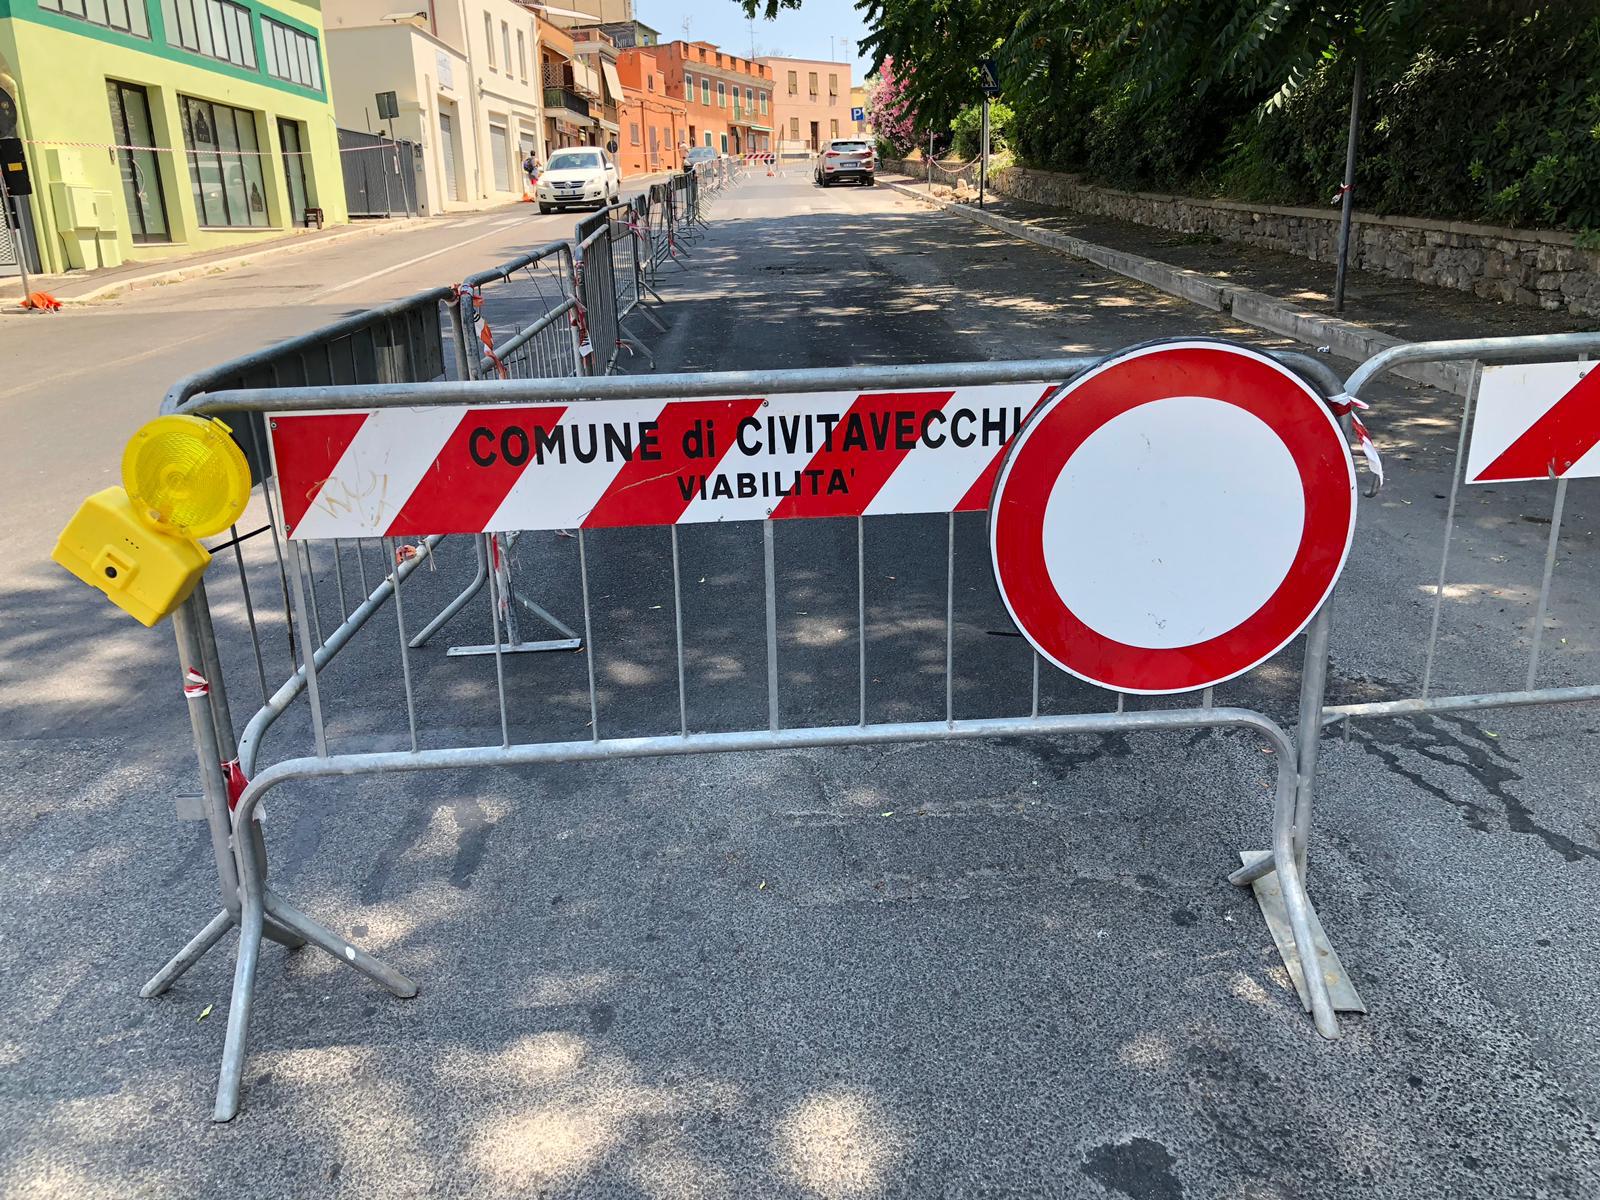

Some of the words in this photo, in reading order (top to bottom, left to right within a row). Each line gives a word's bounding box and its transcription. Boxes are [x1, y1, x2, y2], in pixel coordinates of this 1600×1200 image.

[853, 108, 862, 121] P
[469, 420, 662, 467] COMUNE
[682, 419, 715, 459] di
[736, 406, 1023, 457] CIVITAVECCHI
[677, 469, 857, 501] VIABILITA'
